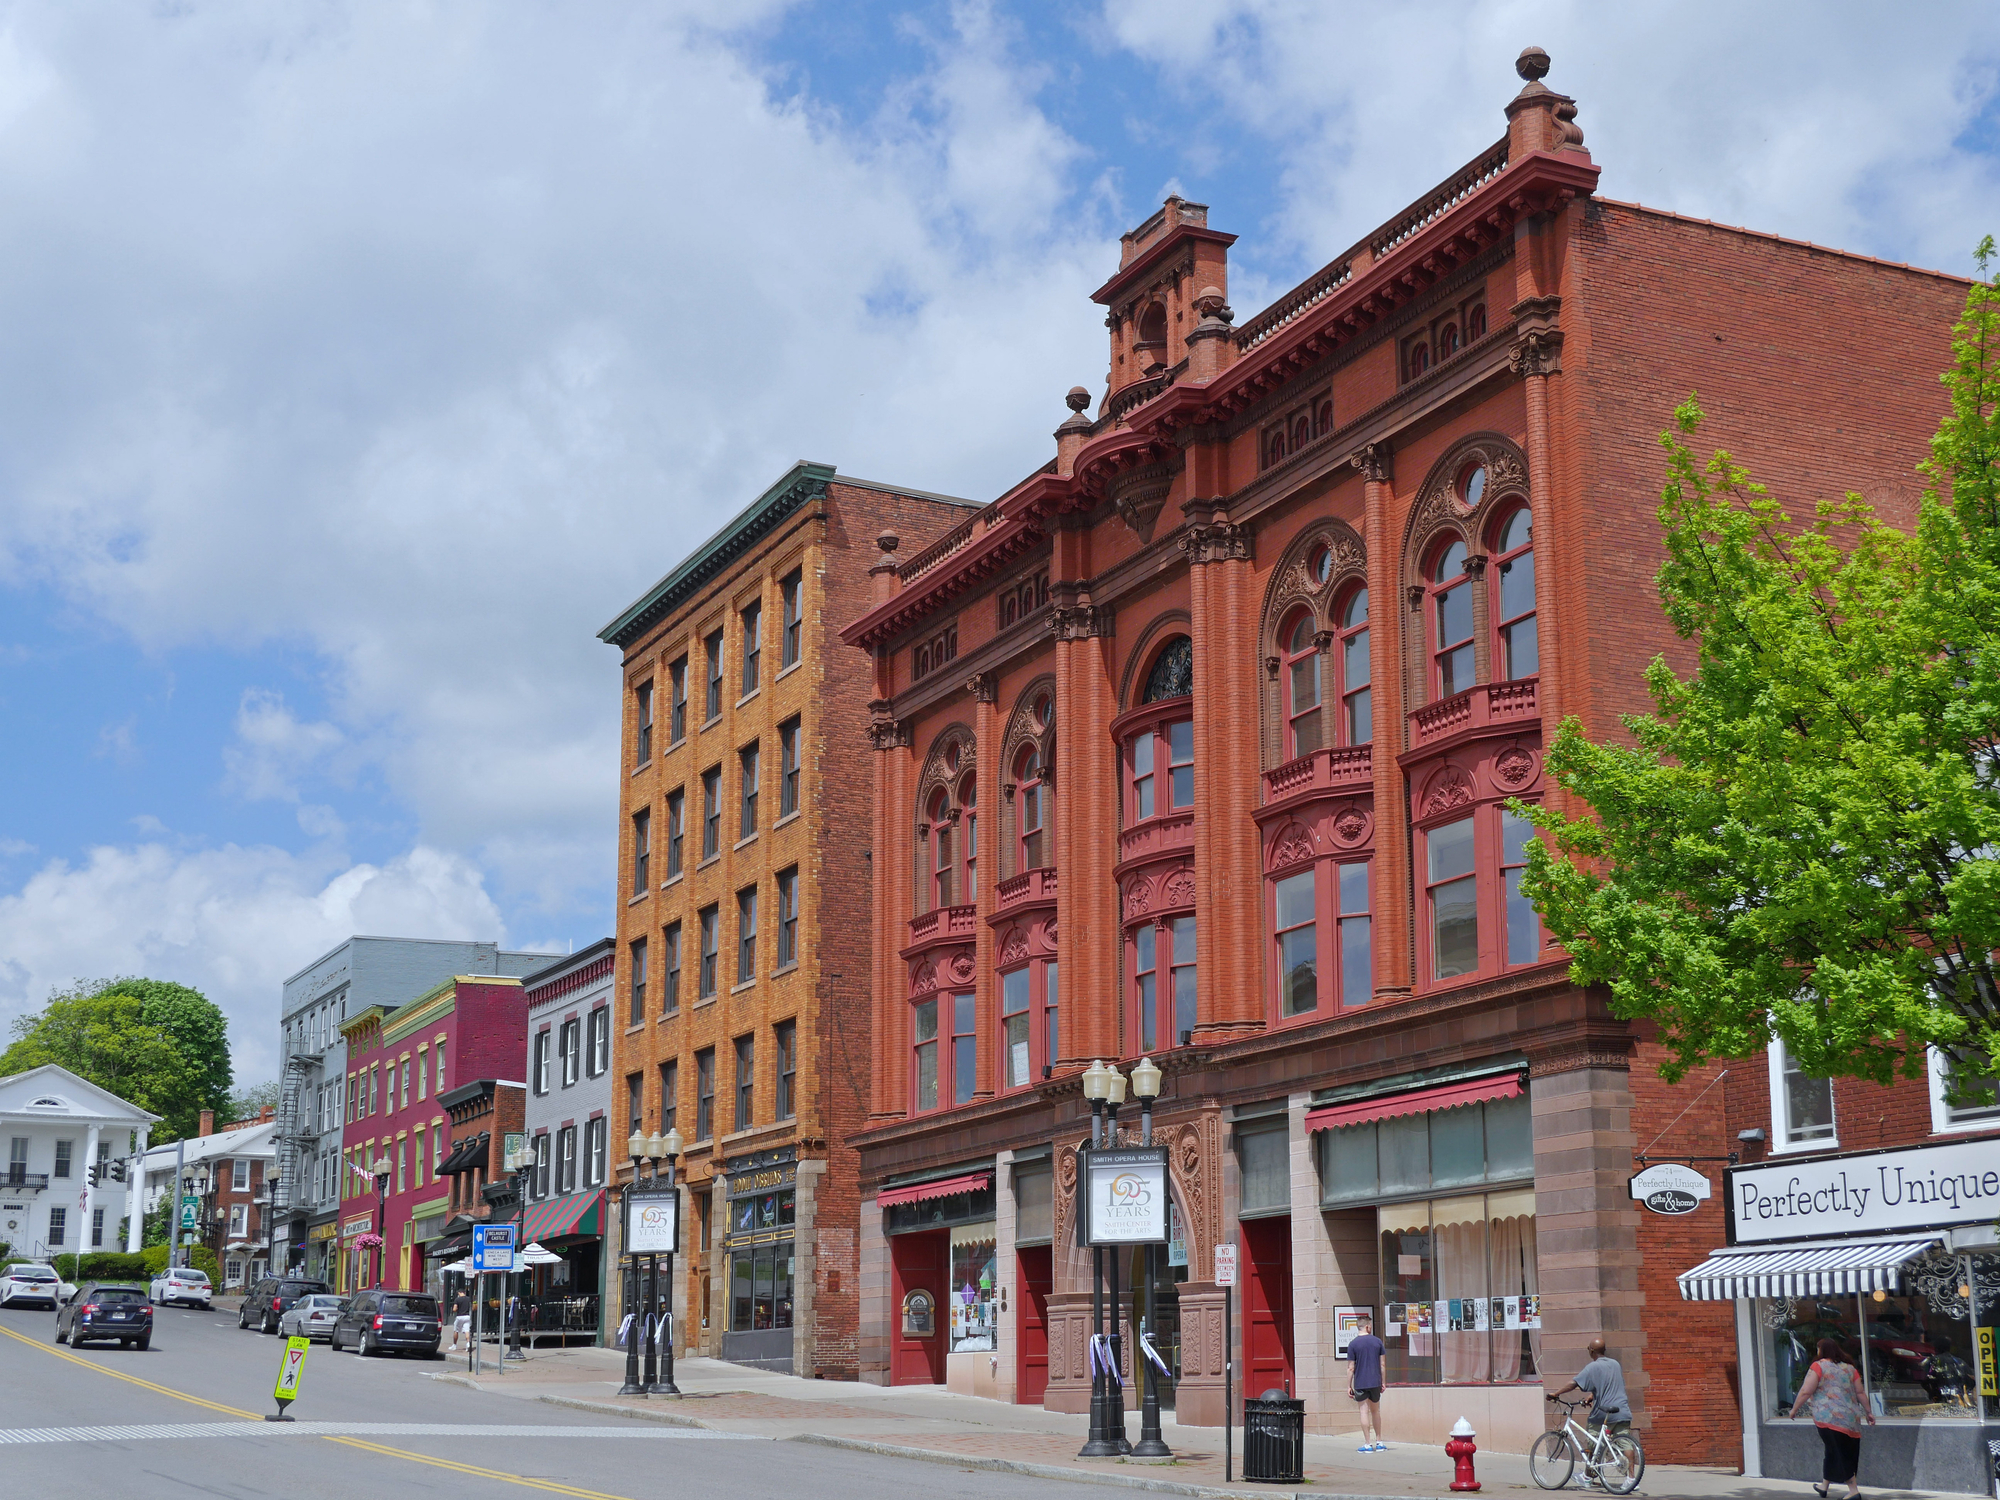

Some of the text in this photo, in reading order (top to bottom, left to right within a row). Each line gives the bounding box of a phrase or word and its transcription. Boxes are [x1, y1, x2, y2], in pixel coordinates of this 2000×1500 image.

[1664, 1167, 1673, 1175] 74
[733, 1175, 752, 1193] EDDIE
[1637, 1177, 1704, 1190] Perfectly Unique
[1105, 1180, 1152, 1207] 125
[1650, 1191, 1695, 1211] gifts & home
[1740, 1166, 2000, 1221] Perfectly Unique
[1105, 1206, 1151, 1218] YEARS
[638, 1211, 667, 1229] 125
[638, 1228, 667, 1236] YEARS
[1221, 1247, 1230, 1256] NO
[1216, 1257, 1235, 1265] PARKING
[1979, 1332, 1995, 1391] OPEN
